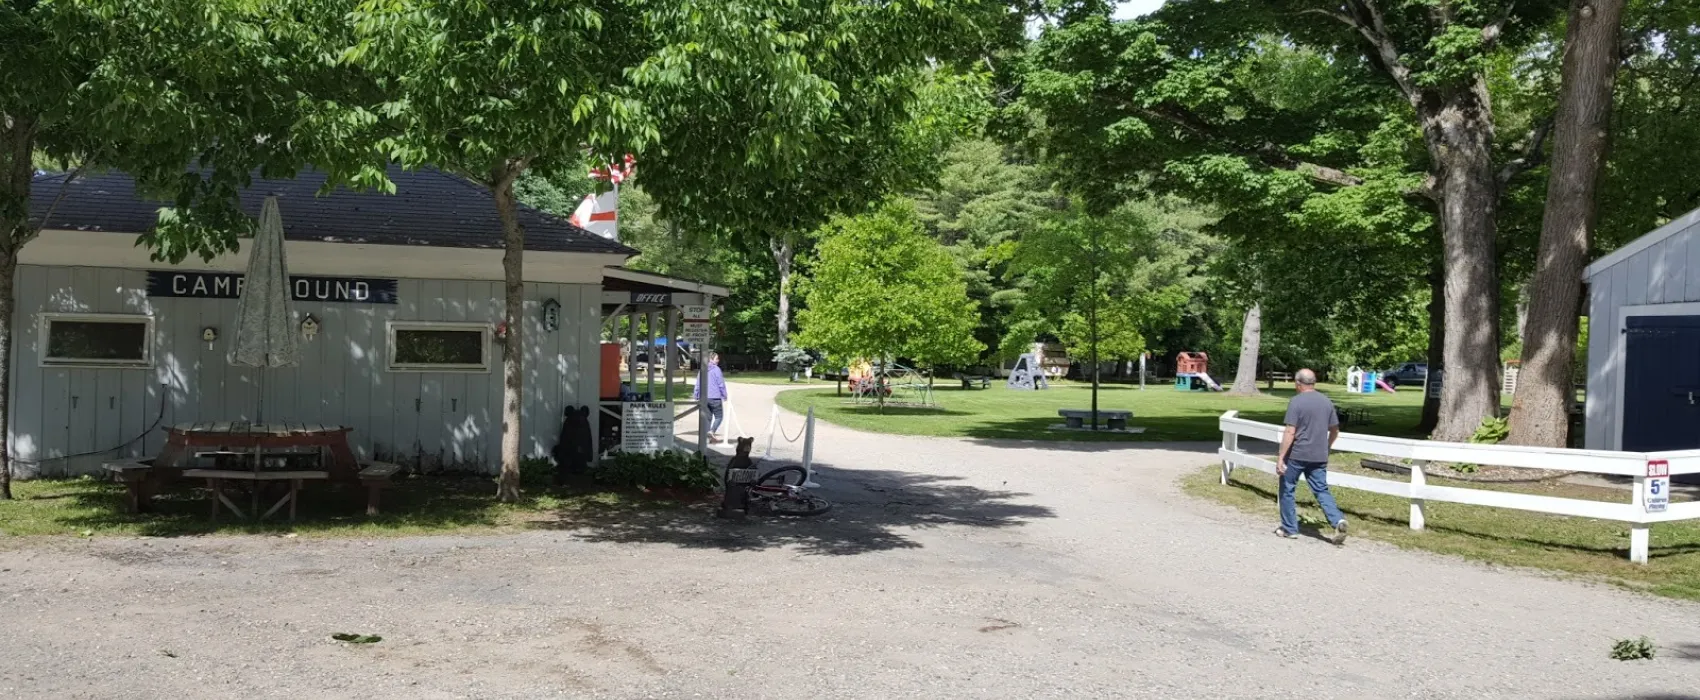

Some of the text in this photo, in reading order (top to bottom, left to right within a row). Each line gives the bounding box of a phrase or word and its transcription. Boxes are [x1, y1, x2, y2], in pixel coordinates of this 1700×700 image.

[172, 275, 369, 300] CAMPOUND
[636, 294, 667, 303] OFFICE
[1648, 464, 1667, 476] SLOW
[1651, 479, 1660, 494] 5
